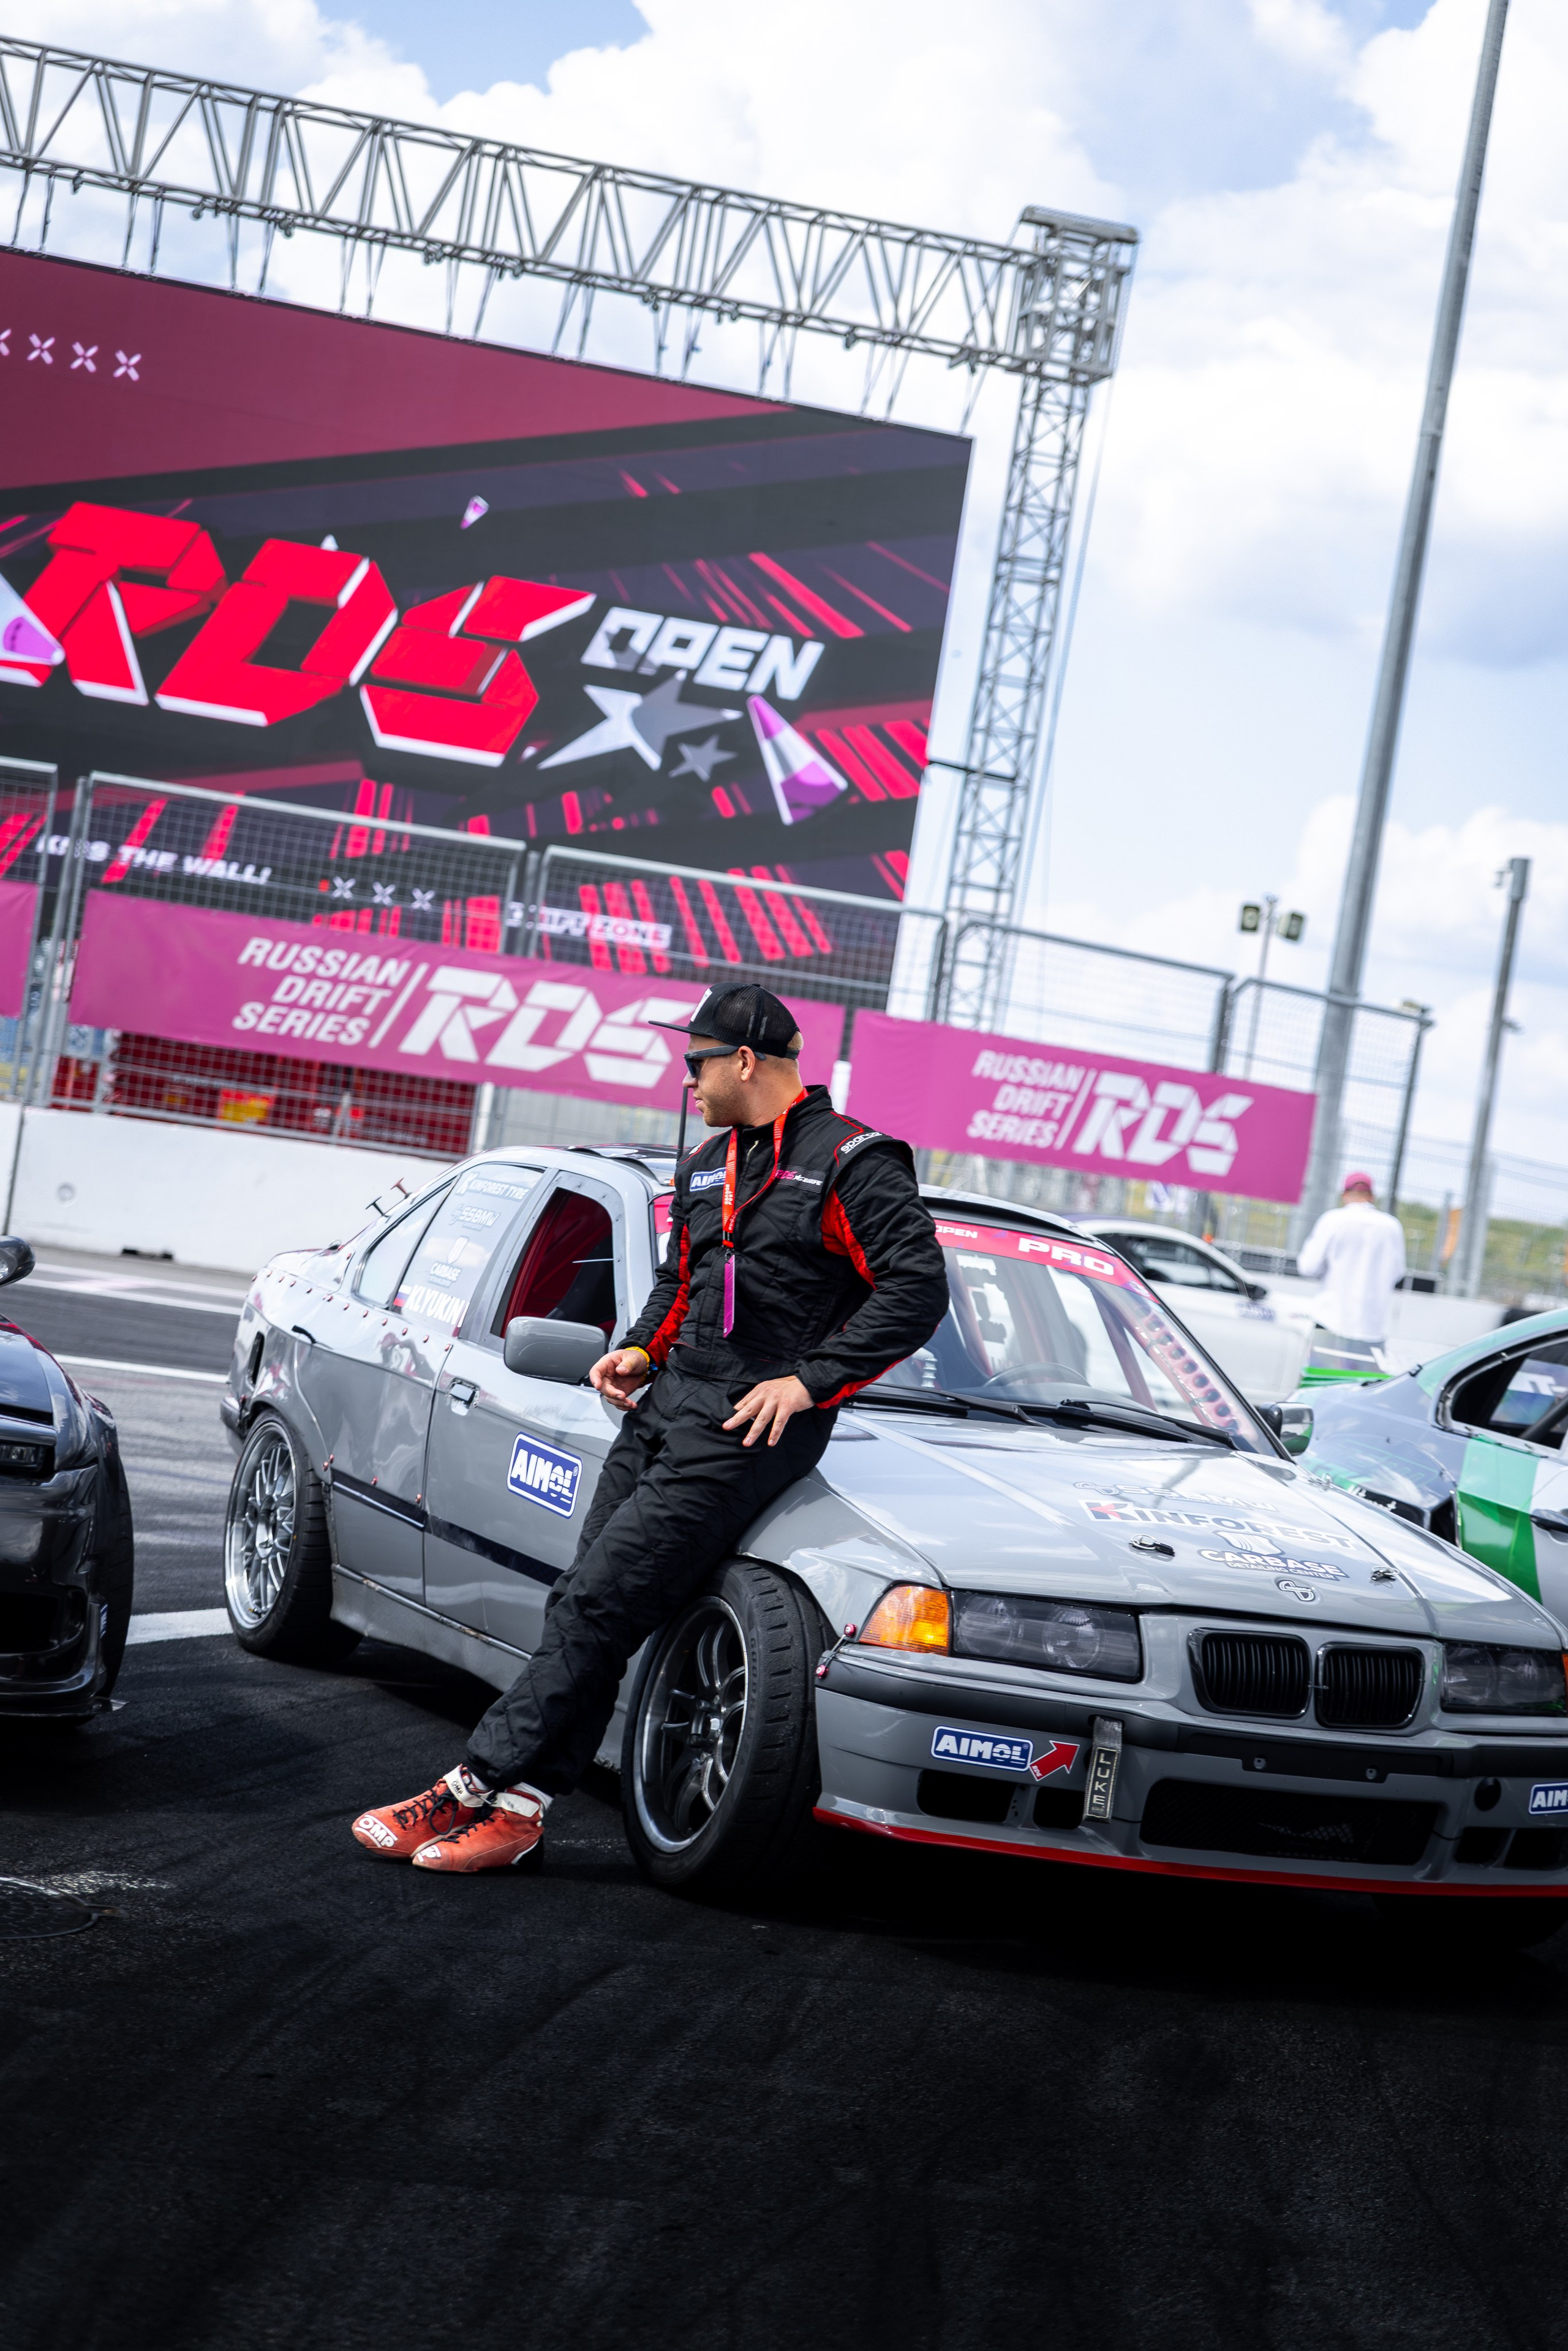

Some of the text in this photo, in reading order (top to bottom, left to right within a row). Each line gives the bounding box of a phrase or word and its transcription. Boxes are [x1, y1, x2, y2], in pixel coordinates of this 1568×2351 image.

[0, 501, 596, 768] RDS
[581, 606, 824, 700] OPEN
[118, 844, 179, 873] THE
[236, 936, 412, 987] RUSSIAN
[271, 974, 393, 1016] DRIFT
[232, 1001, 371, 1046] SERIES
[398, 965, 696, 1089] RDS
[971, 1049, 1087, 1093] RUSSIAN
[992, 1082, 1074, 1120] DRIFT
[967, 1109, 1060, 1149] SERIES
[1072, 1071, 1254, 1176] RDS
[505, 1185, 529, 1200] TYRE
[458, 1206, 500, 1227] SSBMW
[430, 1262, 462, 1281] CARBASE
[1019, 1237, 1114, 1276] PRO
[404, 1284, 466, 1326] KLYUKIN
[511, 1448, 574, 1504] AIMOL
[1085, 1501, 1352, 1549] KINFOREST
[1200, 1549, 1346, 1577] CARBASE
[1228, 1561, 1335, 1580] DETAILING CENTER
[935, 1734, 1027, 1764] AIMOL
[452, 1779, 463, 1795] OMP
[1093, 1753, 1111, 1805] LUKE
[1532, 1789, 1568, 1808] AIM
[358, 1816, 395, 1847] OMP
